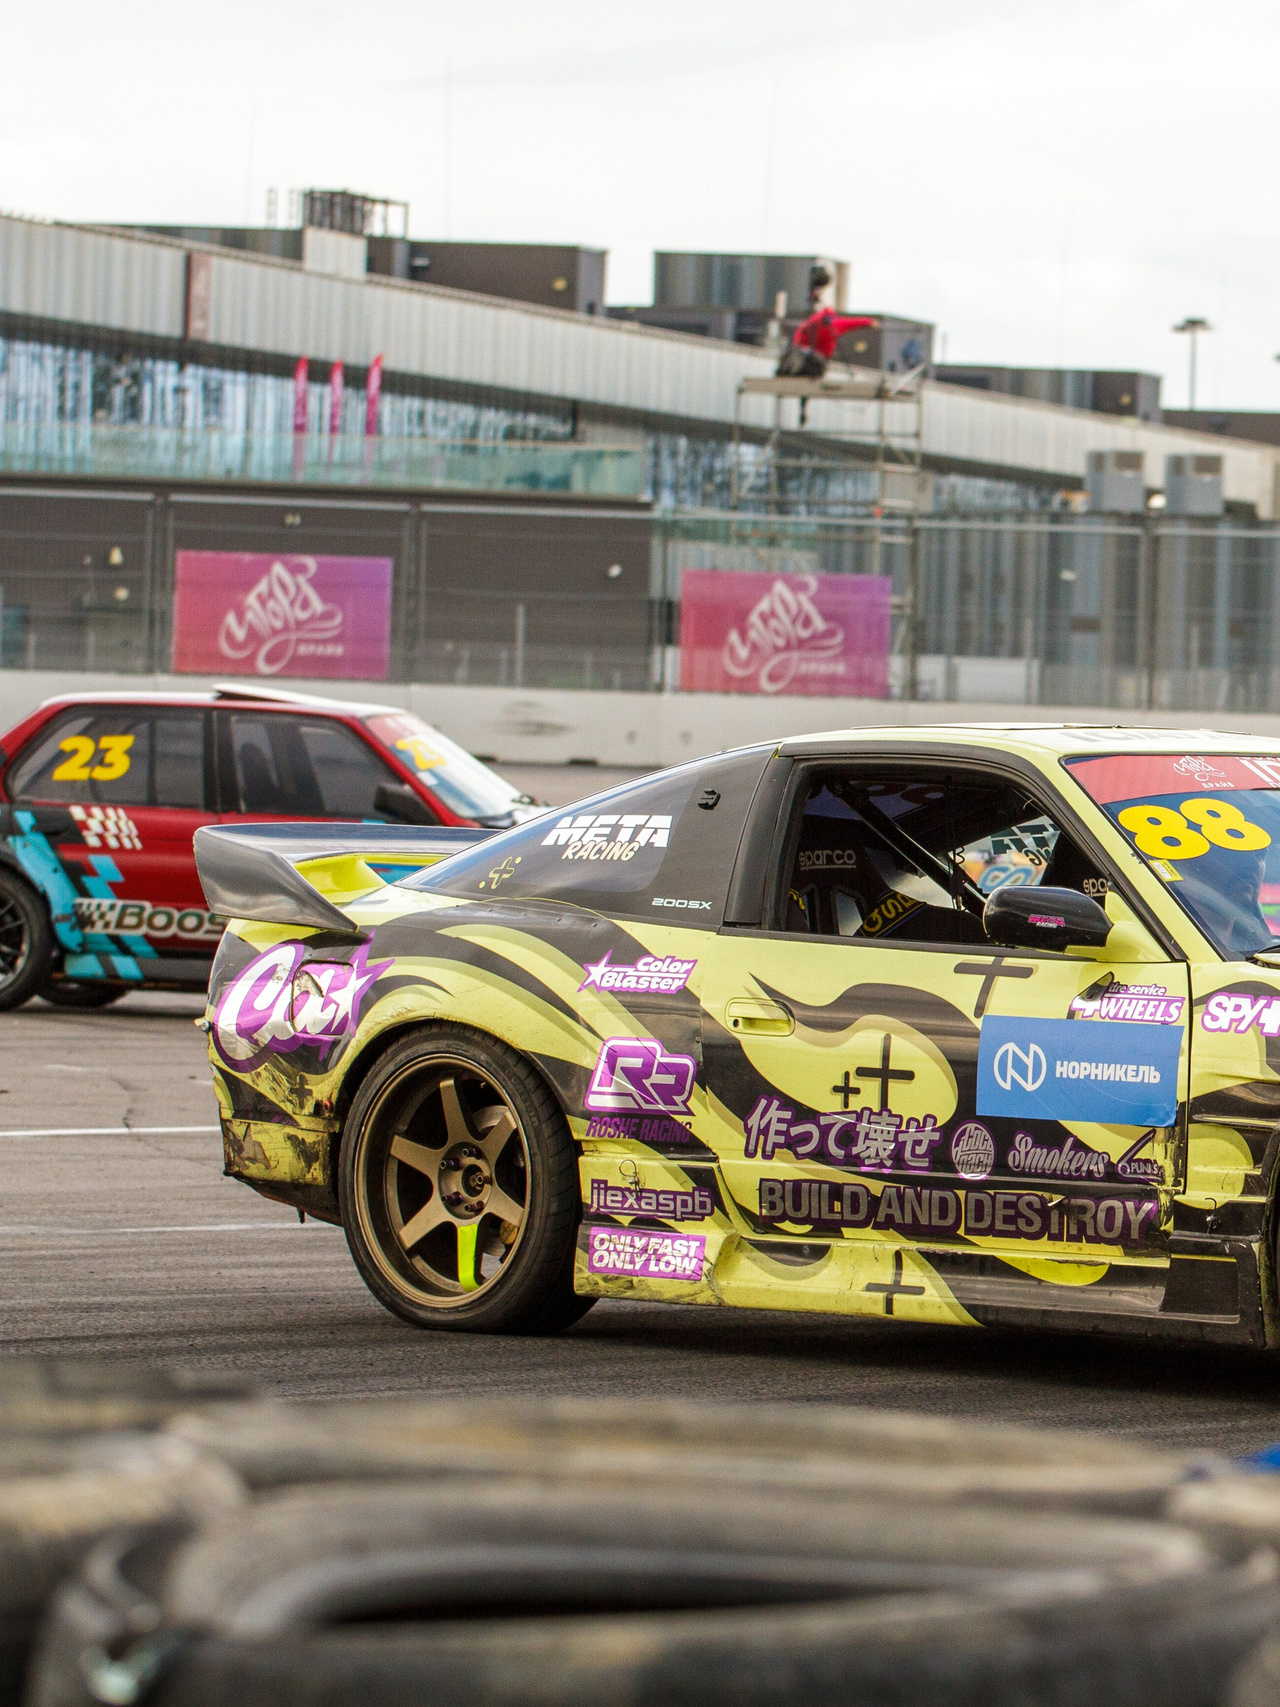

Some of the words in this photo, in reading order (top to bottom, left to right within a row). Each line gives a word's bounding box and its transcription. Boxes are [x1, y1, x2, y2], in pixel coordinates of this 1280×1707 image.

[53, 735, 135, 780] 23
[541, 815, 673, 847] META
[1118, 798, 1272, 860] 88
[562, 841, 641, 861] RACING
[651, 897, 713, 910] 200SX
[636, 956, 694, 974] Color
[600, 971, 686, 991] Blaster
[1128, 984, 1166, 996] service
[1055, 1060, 1161, 1084] НОРНИКЕЛЬ
[585, 1116, 639, 1140] ROSHE
[639, 1118, 693, 1143] RACING
[747, 1098, 941, 1168] 作って壊せ
[1008, 1133, 1109, 1178] Smokers
[761, 1180, 869, 1222] BUILD
[876, 1186, 957, 1227] AND
[966, 1192, 1155, 1240] DESTROY
[593, 1233, 648, 1253] ONLY
[647, 1237, 701, 1258] FAST
[592, 1251, 648, 1271] ONLY
[648, 1254, 700, 1275] LOW
